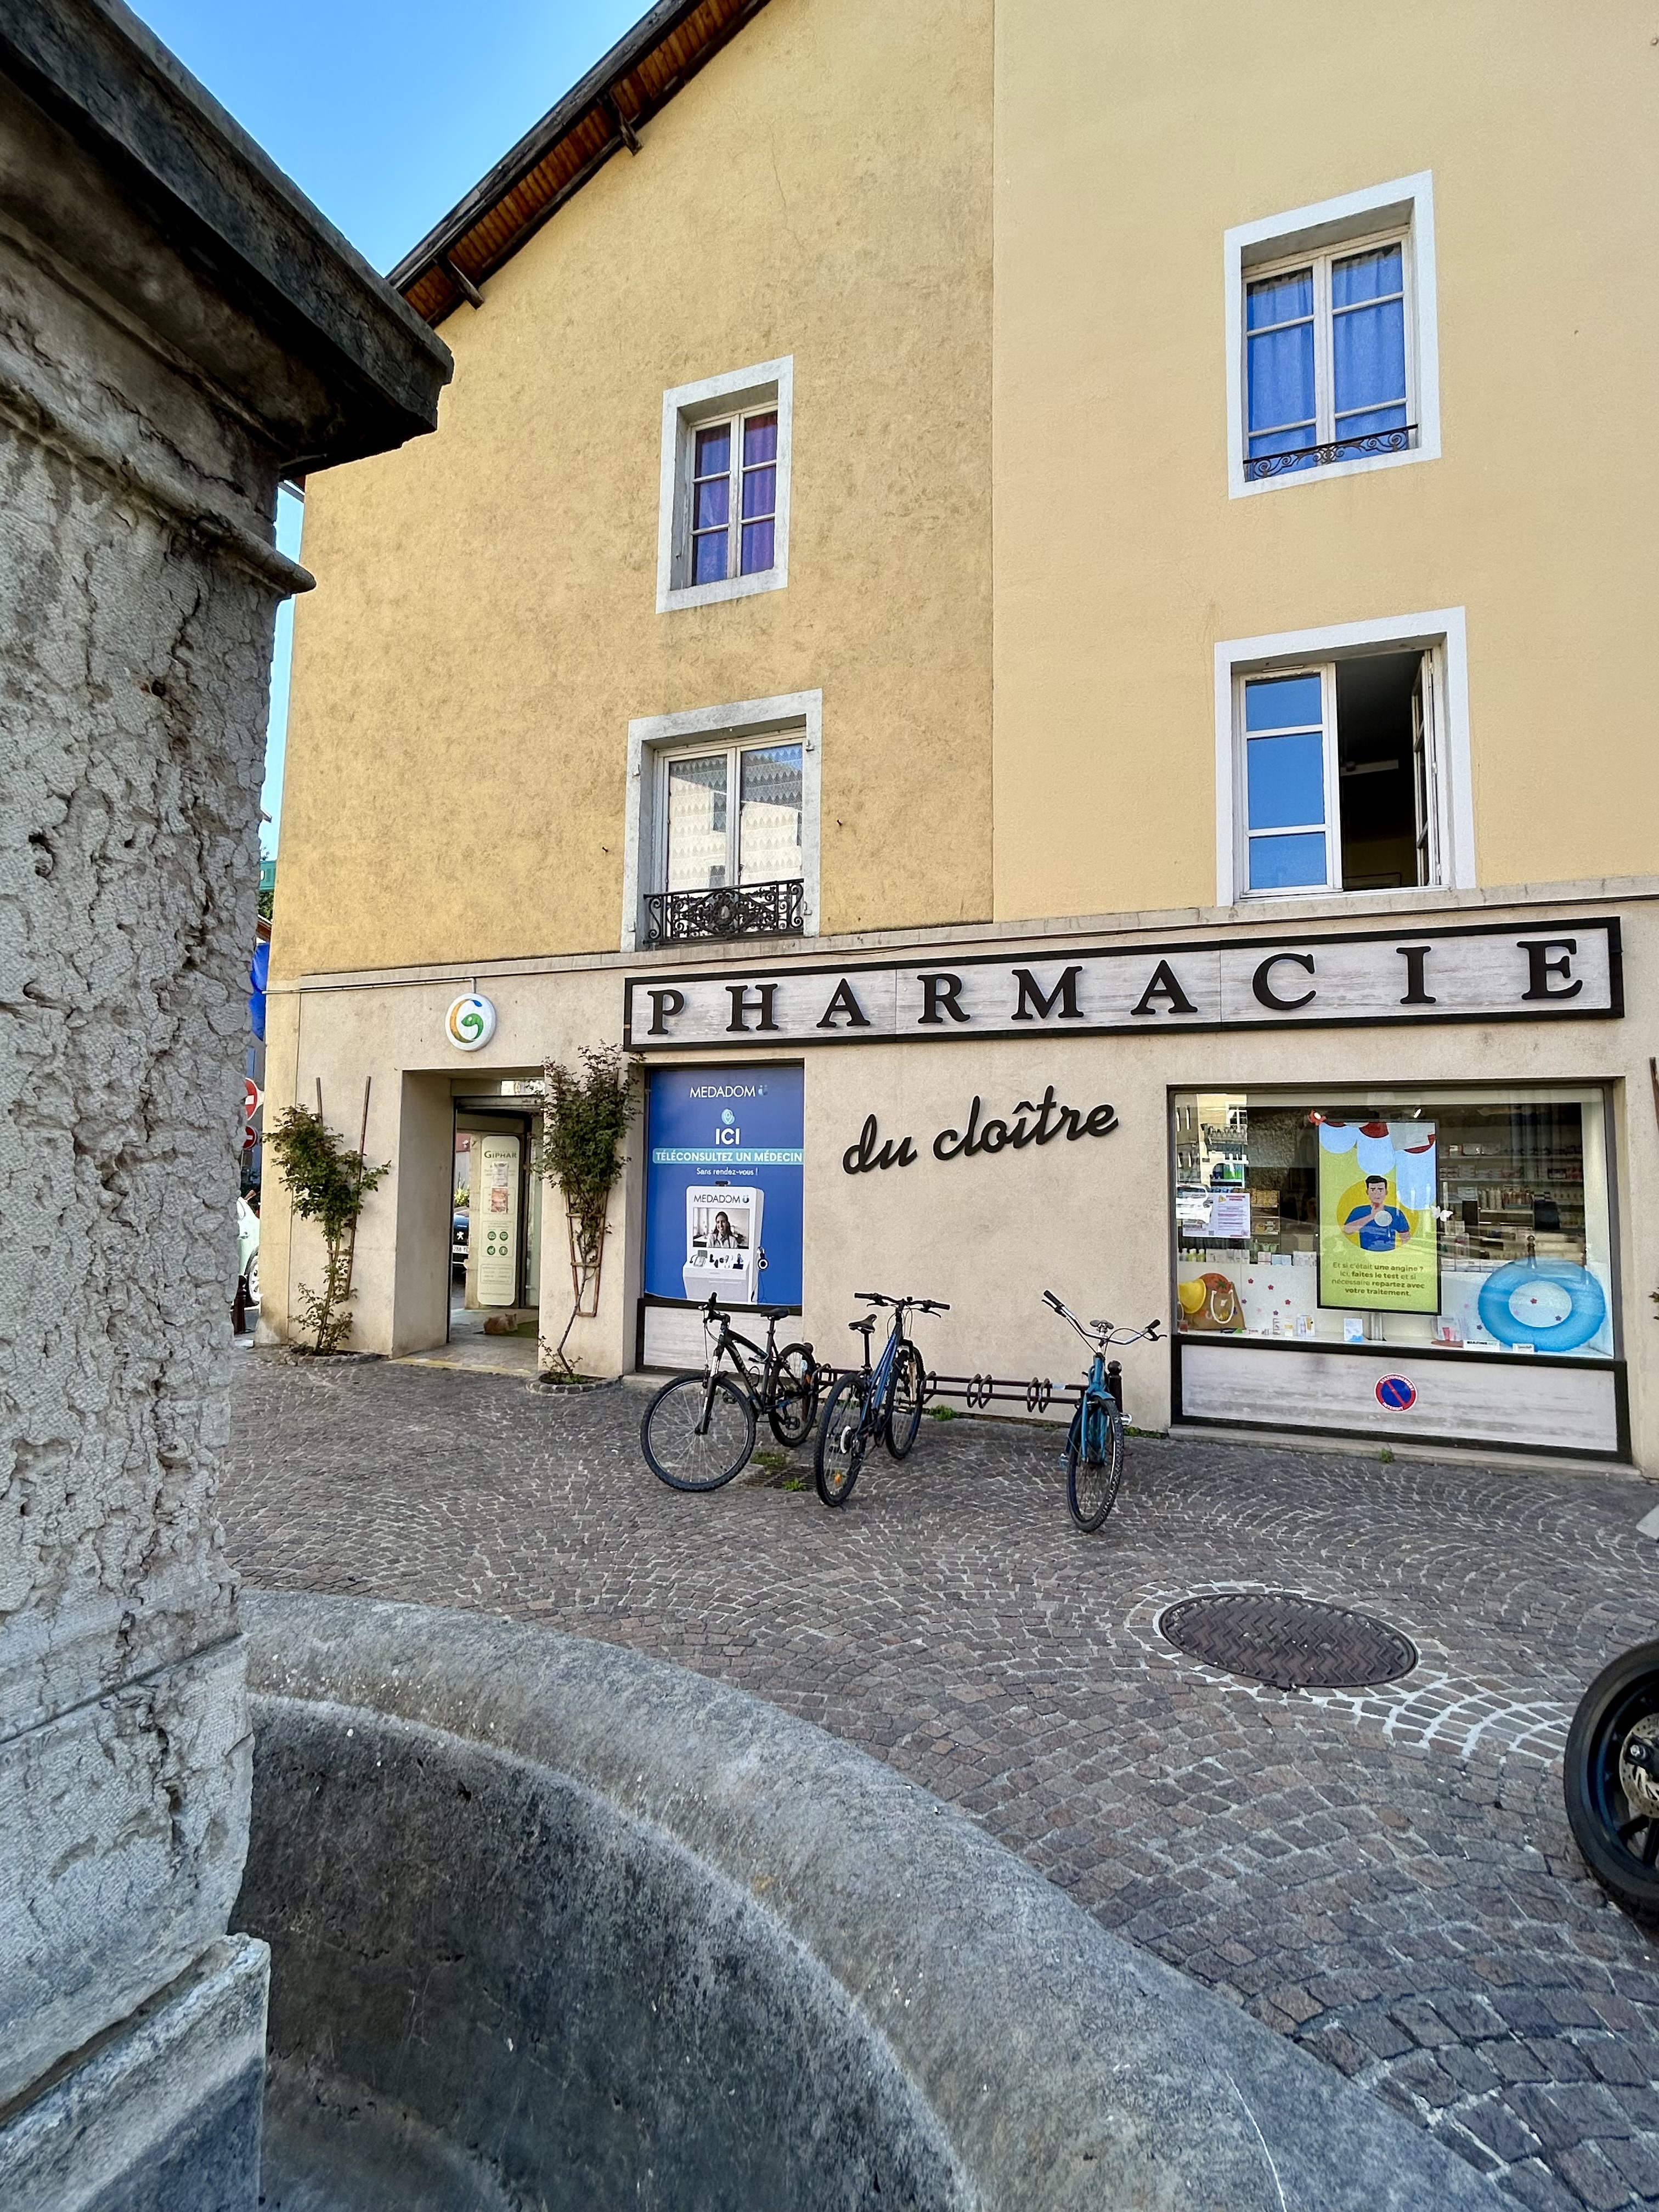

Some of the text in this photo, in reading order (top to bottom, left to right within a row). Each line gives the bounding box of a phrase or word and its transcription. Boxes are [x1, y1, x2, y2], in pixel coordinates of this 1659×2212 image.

[647, 938, 1583, 1035] PHARMACIE
[689, 1085, 756, 1098] MEDADOM
[715, 1128, 740, 1145] ICI
[842, 1085, 1119, 1175] du cloître
[656, 1148, 802, 1163] TÉLÉCONSULTEZ UN MÉDECIN
[713, 1167, 754, 1176] rendez-vous
[693, 1194, 741, 1204] MEDADOM
